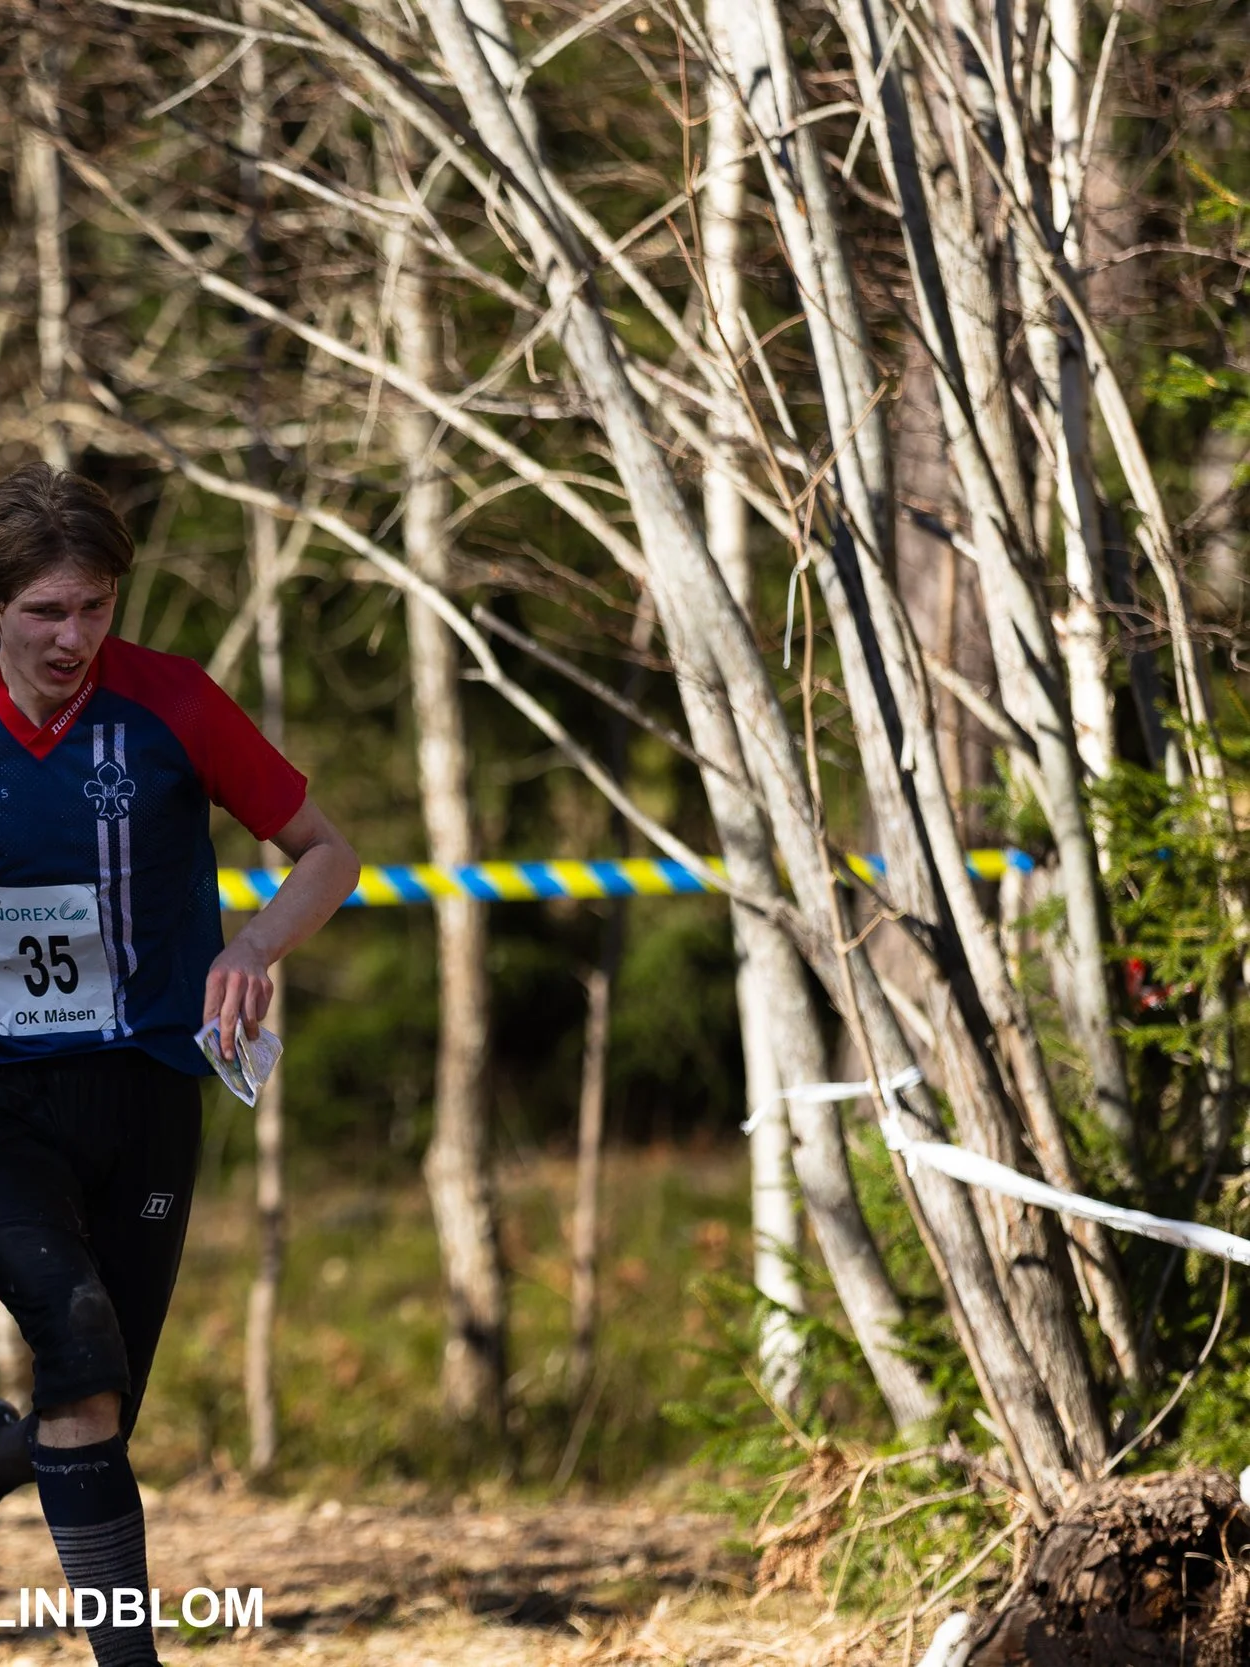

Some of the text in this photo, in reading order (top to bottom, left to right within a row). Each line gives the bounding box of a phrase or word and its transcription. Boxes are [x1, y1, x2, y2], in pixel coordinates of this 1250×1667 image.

[51, 681, 93, 735] noname
[18, 935, 79, 998] 35
[15, 1008, 96, 1025] OK Måsen
